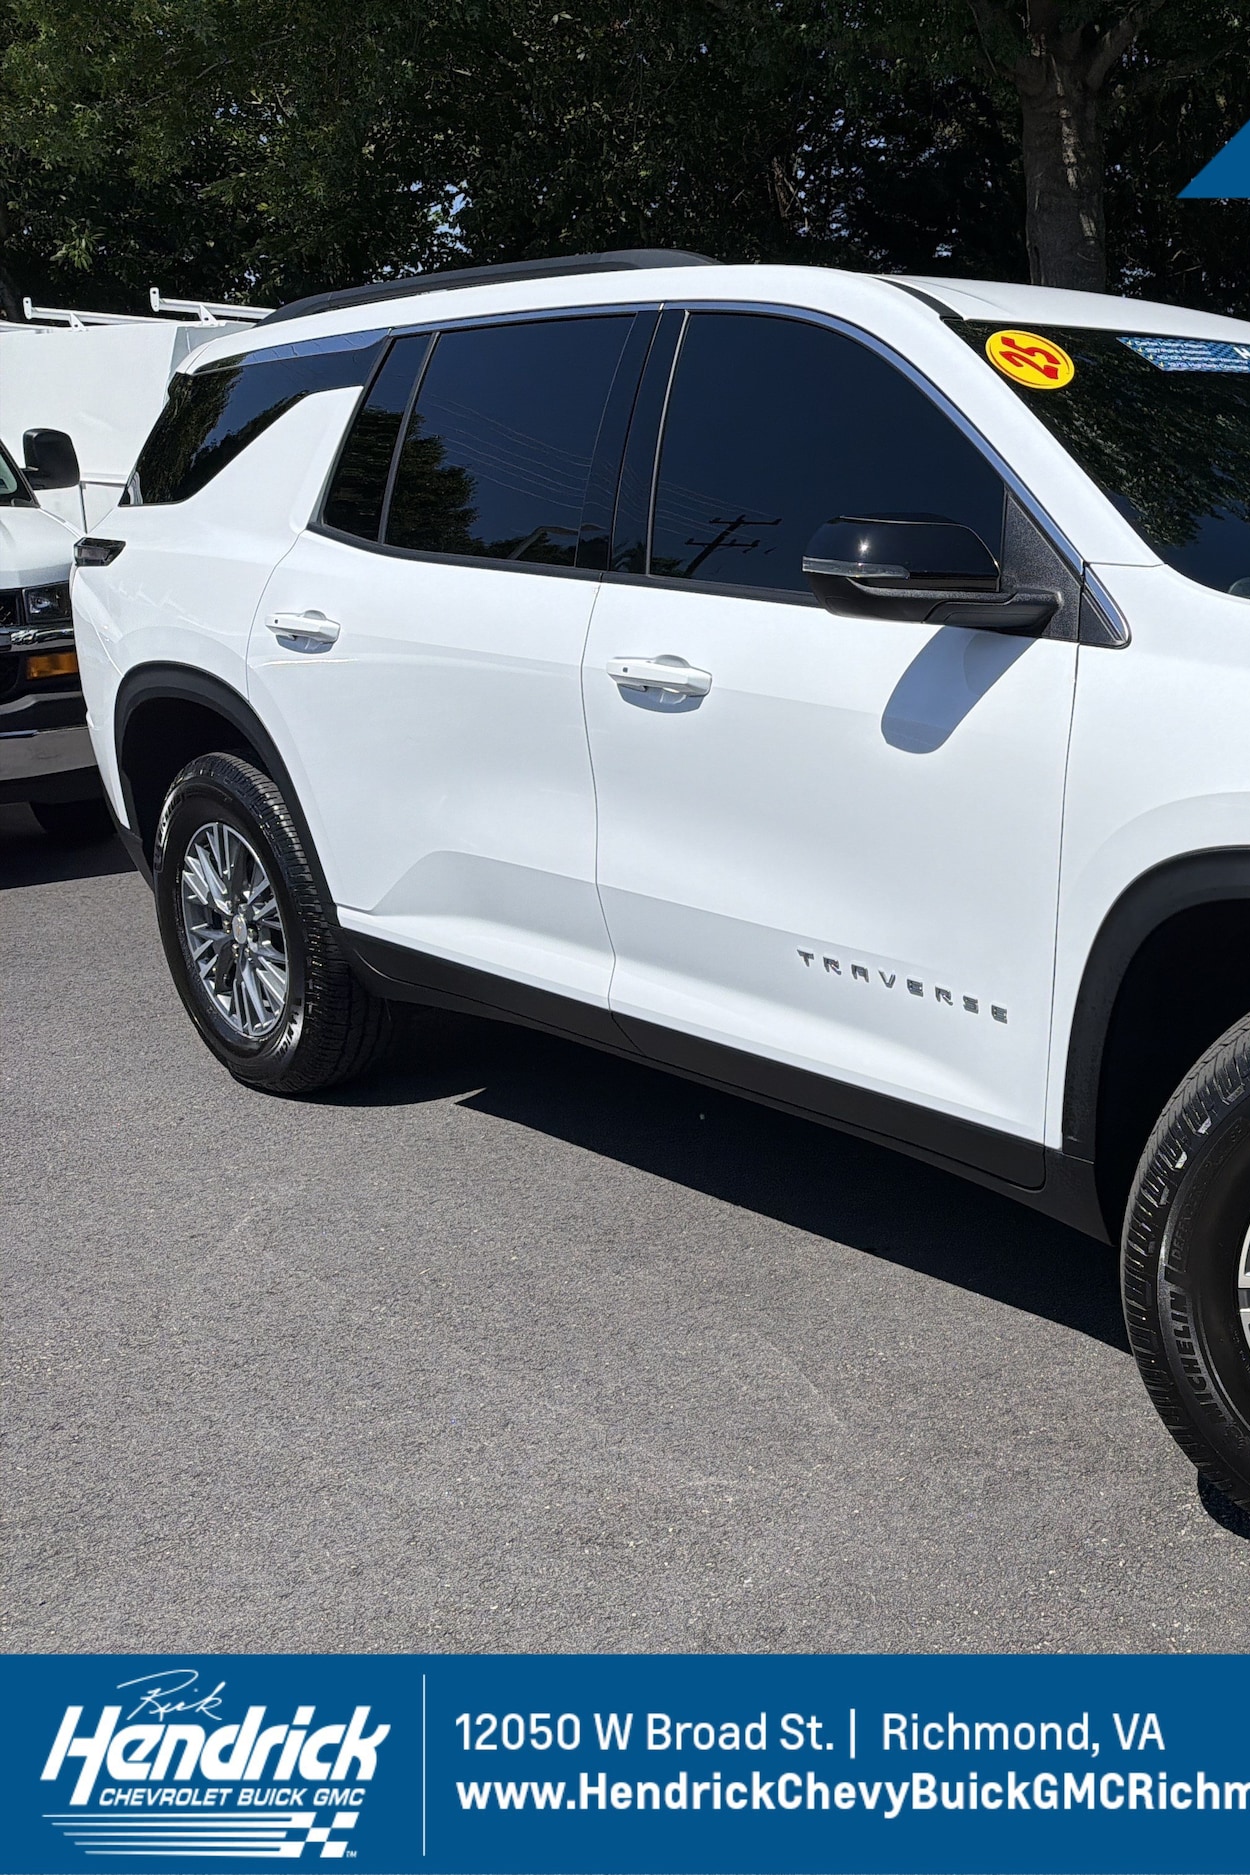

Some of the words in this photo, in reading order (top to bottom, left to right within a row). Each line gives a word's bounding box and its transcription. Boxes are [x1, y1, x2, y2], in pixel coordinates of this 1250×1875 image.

[999, 336, 1061, 380] 25
[797, 947, 1008, 1024] TRAVERSE
[1169, 1290, 1229, 1425] MICHELIN
